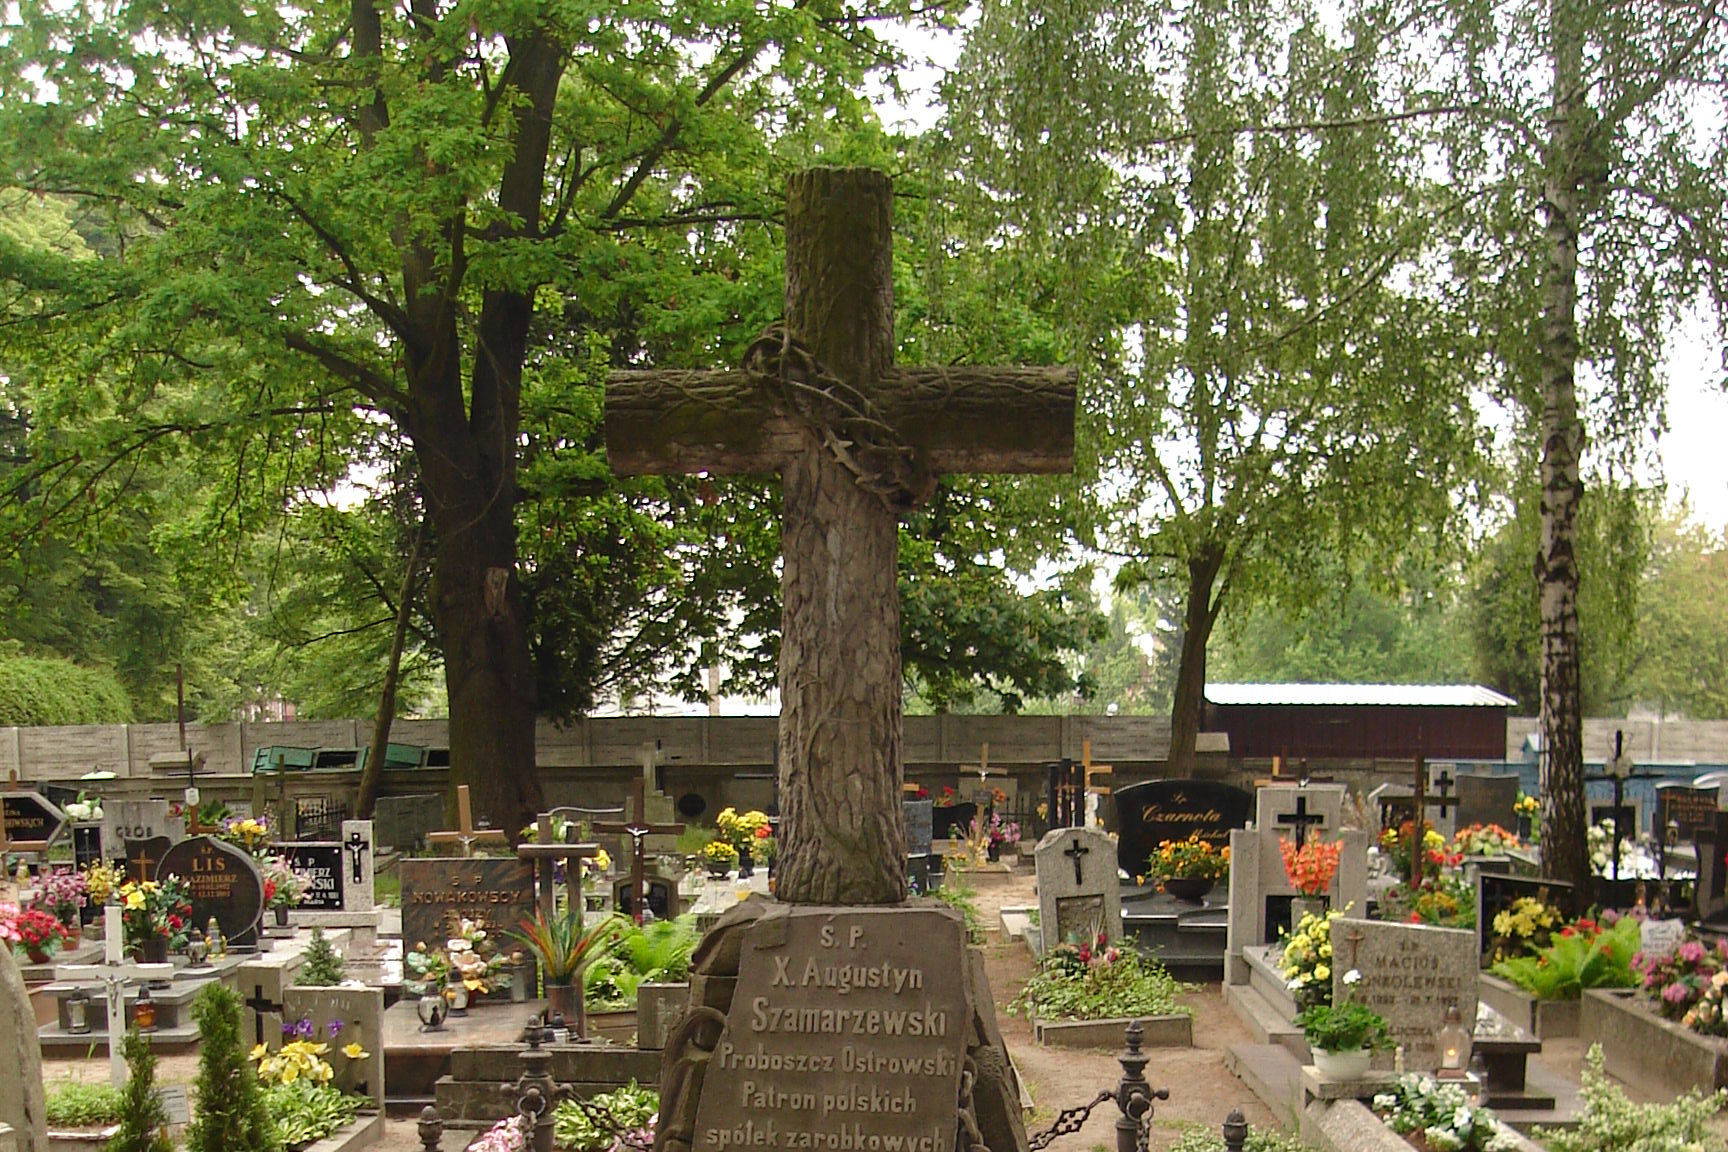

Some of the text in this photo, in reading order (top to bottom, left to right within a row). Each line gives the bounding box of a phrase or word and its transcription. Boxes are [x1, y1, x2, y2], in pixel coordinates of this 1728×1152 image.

[1142, 804, 1222, 823] Czarnota
[192, 857, 226, 871] LIS
[412, 890, 521, 904] NOWAKOWSCY
[771, 955, 923, 995] X. Augustyn
[751, 996, 948, 1038] Szamarzewski
[719, 1044, 957, 1078] Proboszcz Ostrowski
[742, 1080, 917, 1118] Patron polskich
